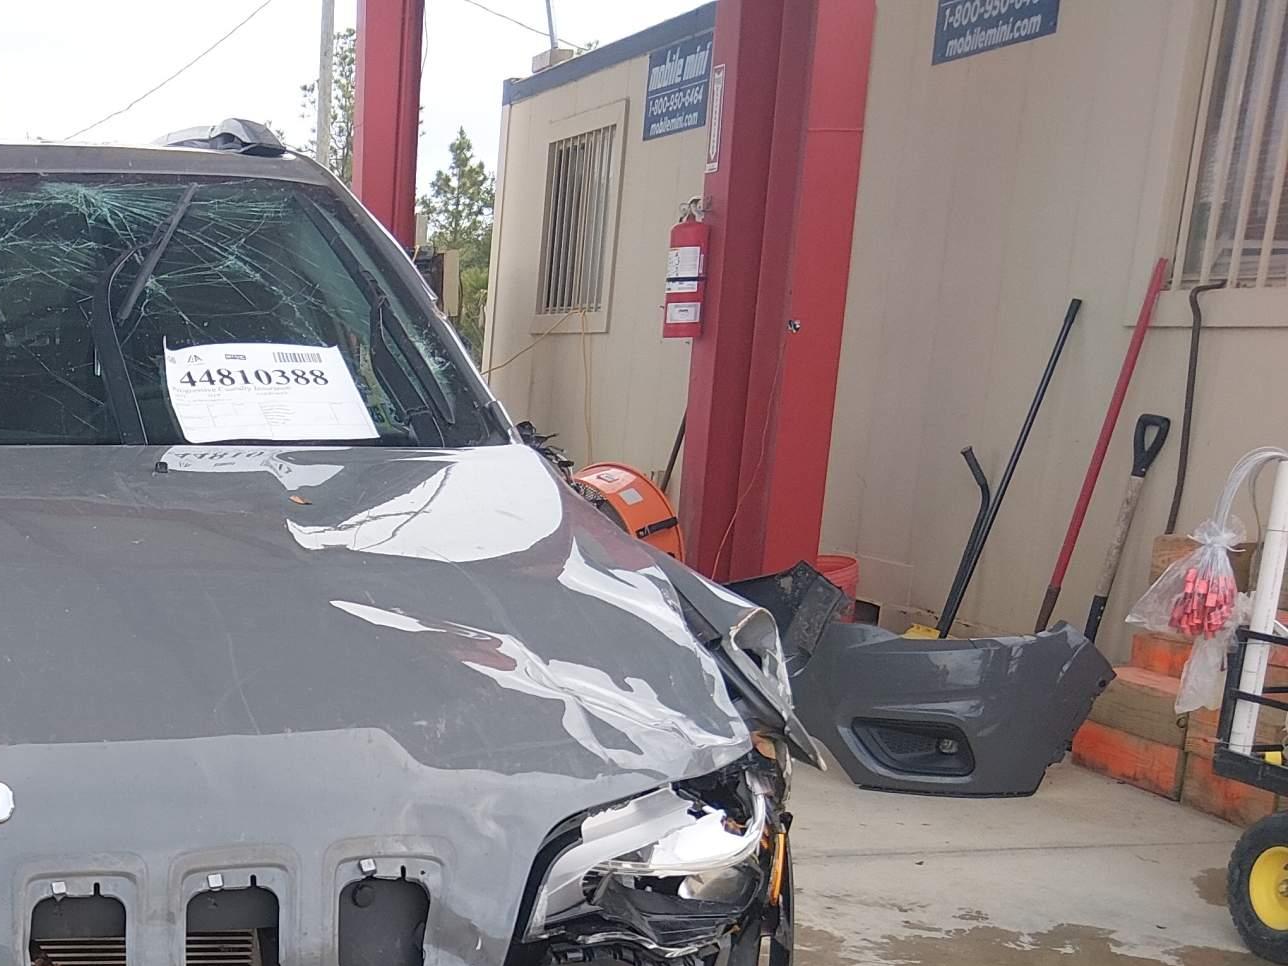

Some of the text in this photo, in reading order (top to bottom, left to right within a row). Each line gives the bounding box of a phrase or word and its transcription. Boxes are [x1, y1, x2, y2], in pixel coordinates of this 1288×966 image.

[945, 14, 1042, 57] mobilemini.com
[648, 41, 712, 92] mobile mini
[648, 85, 705, 117] 1-800-950-6464
[649, 112, 699, 136] mobilemini.com
[179, 367, 329, 387] 44810388
